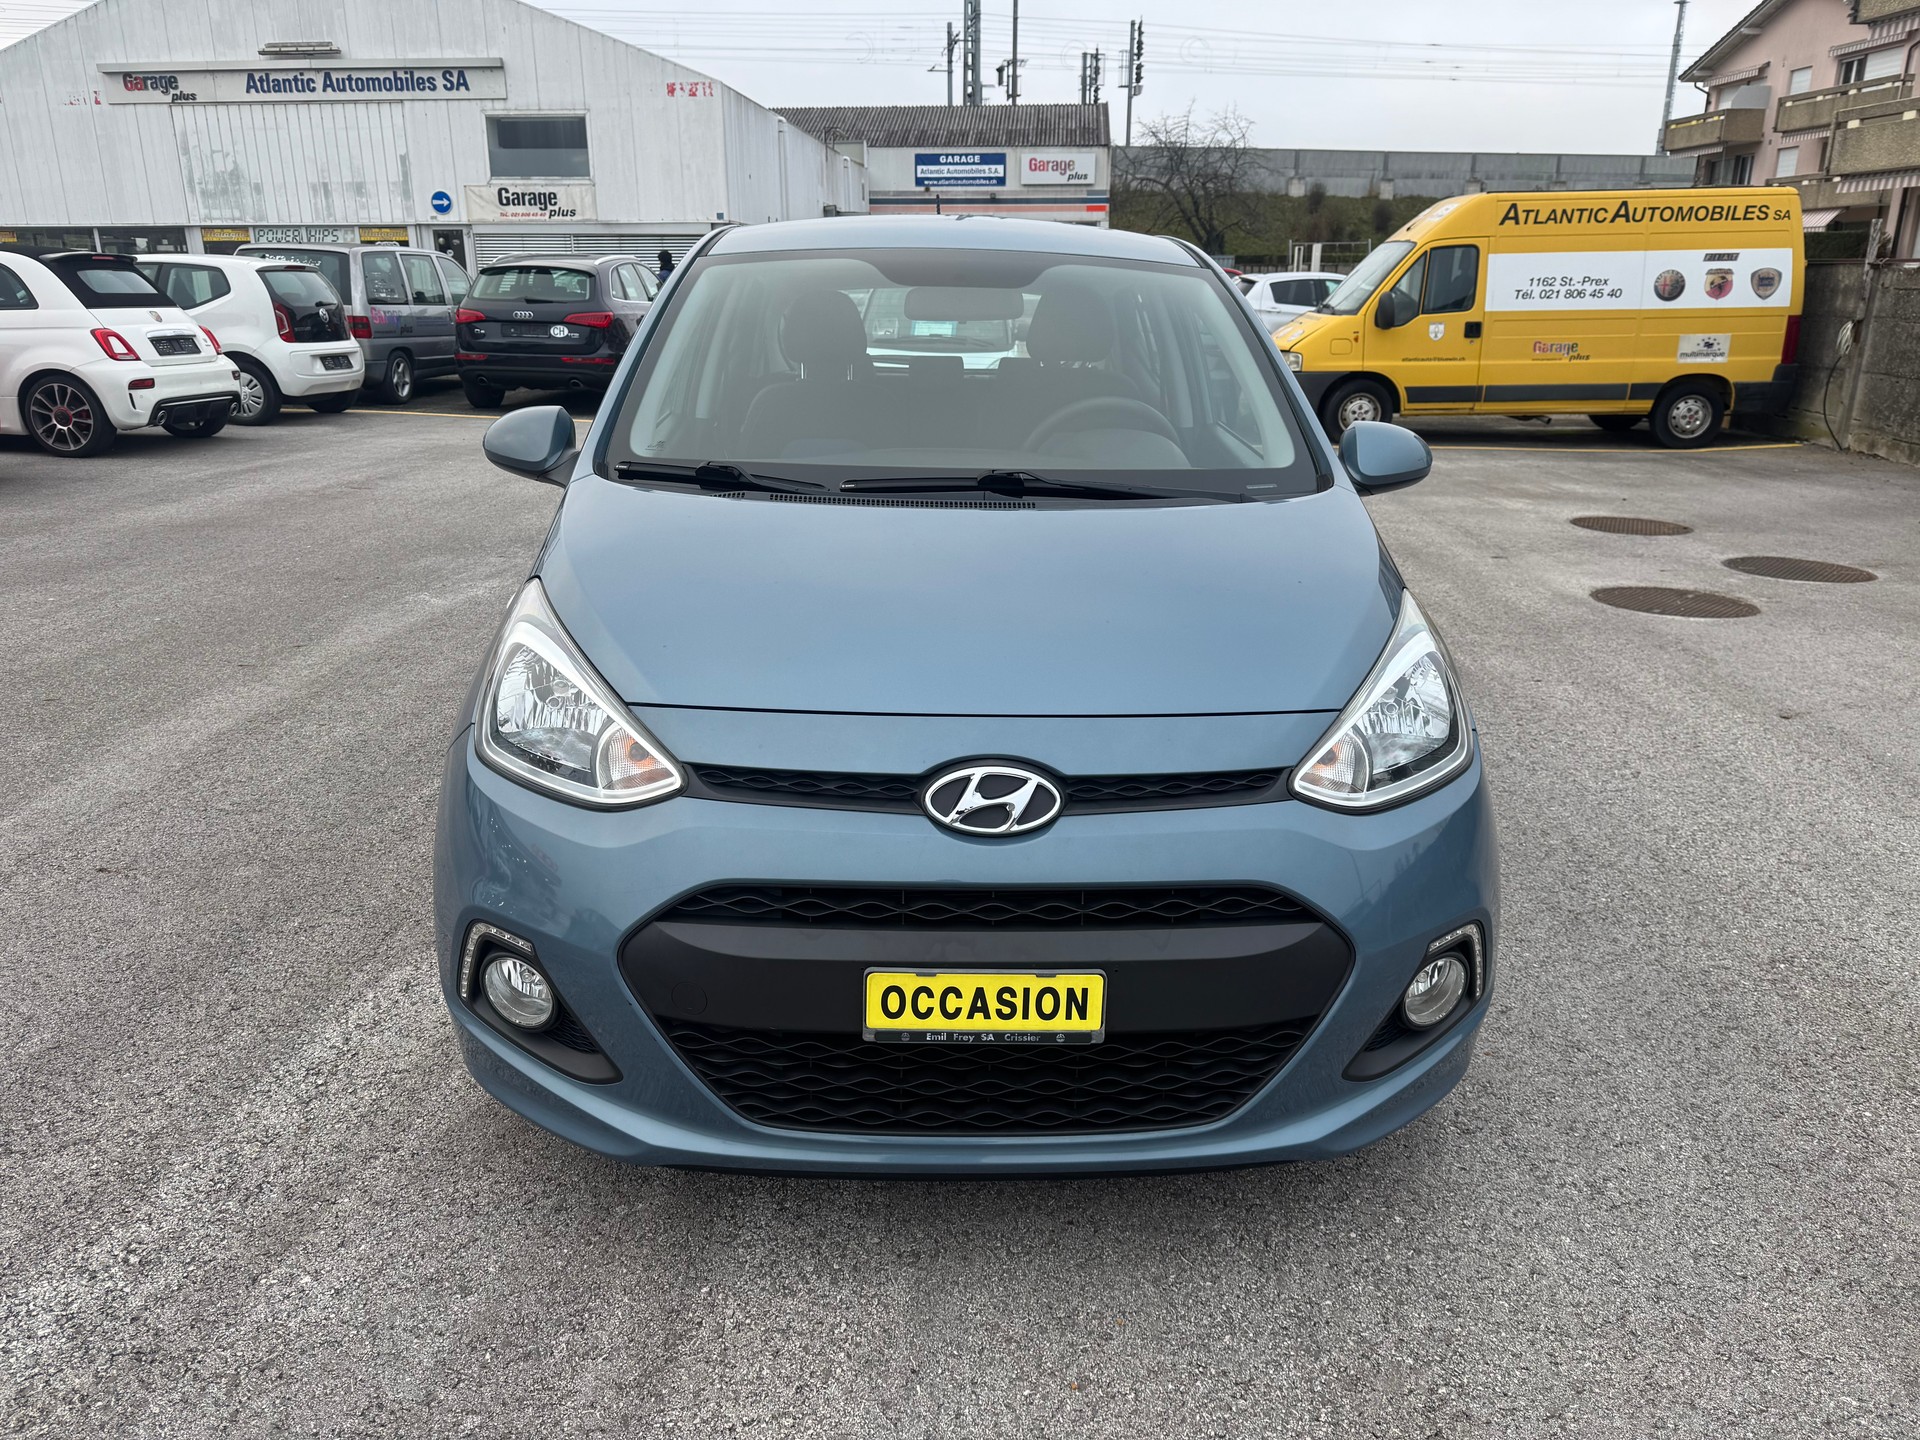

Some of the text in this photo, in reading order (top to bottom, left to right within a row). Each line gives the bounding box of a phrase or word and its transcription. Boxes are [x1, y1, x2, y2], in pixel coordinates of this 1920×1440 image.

[123, 73, 179, 95] Garage
[245, 69, 470, 94] Atlantic Automobiles SA
[171, 91, 197, 103] plus
[939, 155, 981, 163] GARAGE
[920, 167, 1001, 175] Atlantic Automobiles S.A.
[1029, 157, 1075, 175] Garage
[1067, 172, 1088, 182] plus
[497, 187, 558, 211] Garage
[548, 207, 576, 219] plus
[1499, 200, 1791, 226] ATLANTIC AUTOMOBILES SA
[1529, 276, 1609, 287] 1162 St.-Prex
[1514, 288, 1622, 300] Tél. 021 806 45 40
[552, 327, 565, 336] CH
[1533, 341, 1579, 356] Garage
[1569, 353, 1590, 362] plus
[880, 984, 1089, 1021] OCCASION
[926, 1033, 947, 1041] Emil
[953, 1033, 975, 1043] Frey
[1004, 1033, 1041, 1042] Crissier
